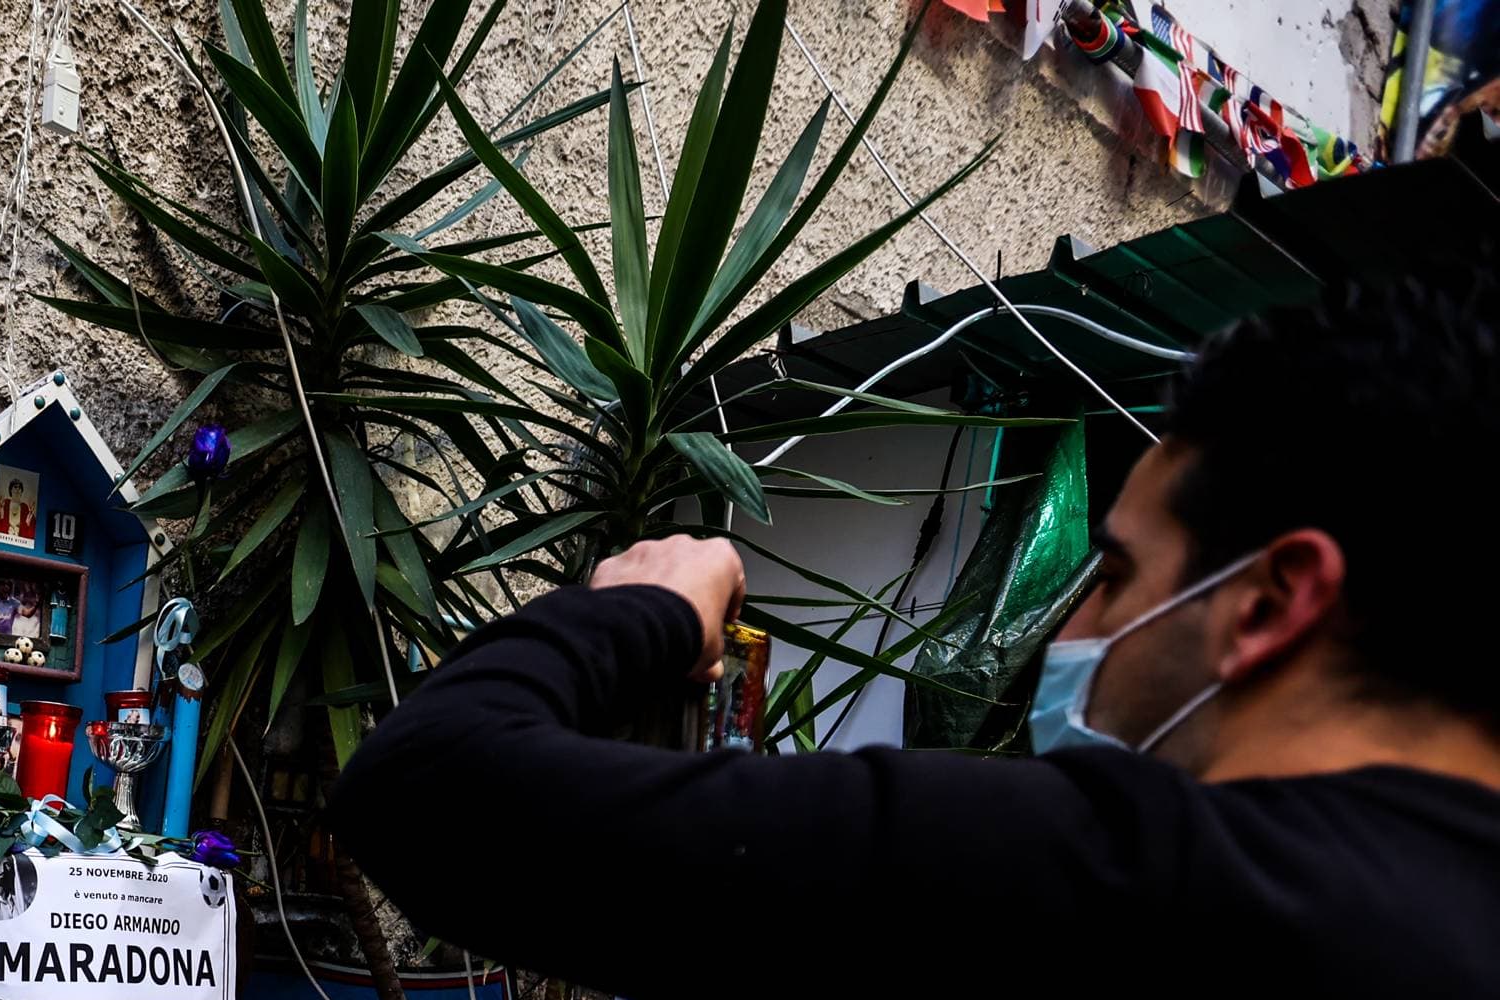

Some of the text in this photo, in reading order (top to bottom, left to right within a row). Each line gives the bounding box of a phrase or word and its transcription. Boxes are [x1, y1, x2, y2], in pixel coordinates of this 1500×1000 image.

[53, 512, 76, 540] 10
[68, 867, 169, 883] 25 NOVEMBRE 2020
[74, 889, 80, 900] è
[83, 891, 119, 901] venuto
[127, 894, 163, 905] mancare
[50, 913, 180, 935] DIEGO ARMANDO
